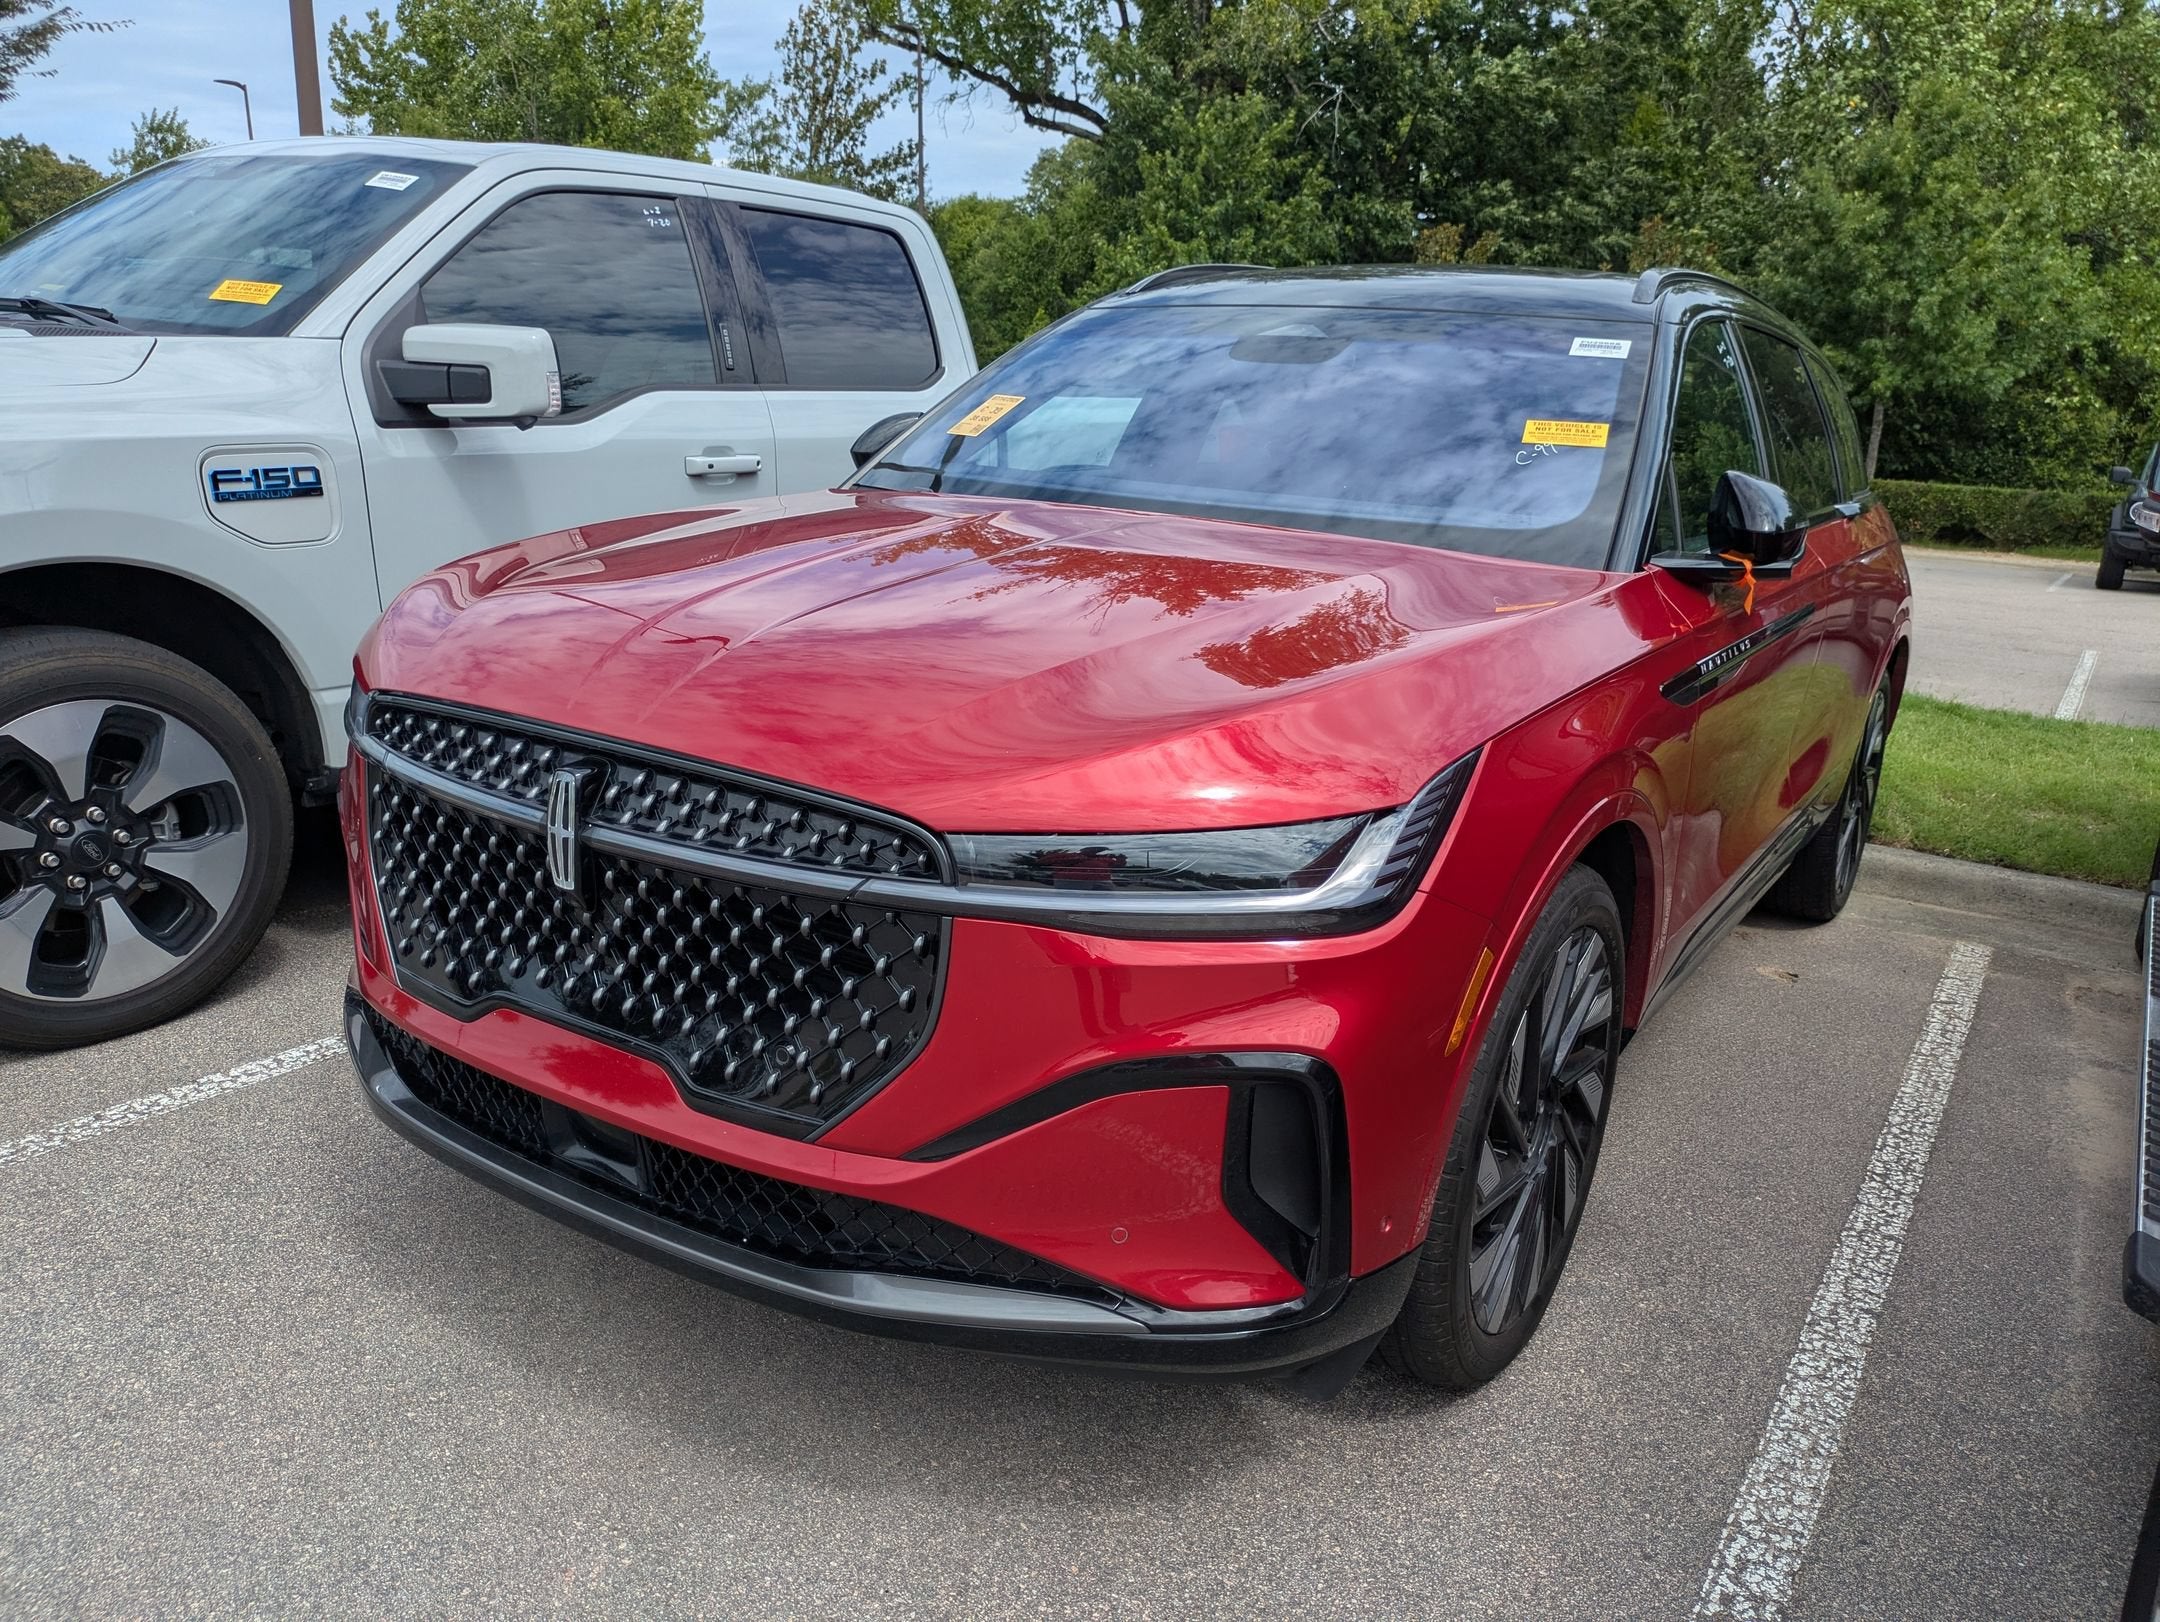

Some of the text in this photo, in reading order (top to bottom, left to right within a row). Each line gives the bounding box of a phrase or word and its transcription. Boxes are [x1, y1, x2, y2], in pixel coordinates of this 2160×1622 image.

[208, 465, 322, 492] F-150
[218, 490, 293, 501] PLATINUM
[1700, 639, 1751, 675] NAUTILUS
